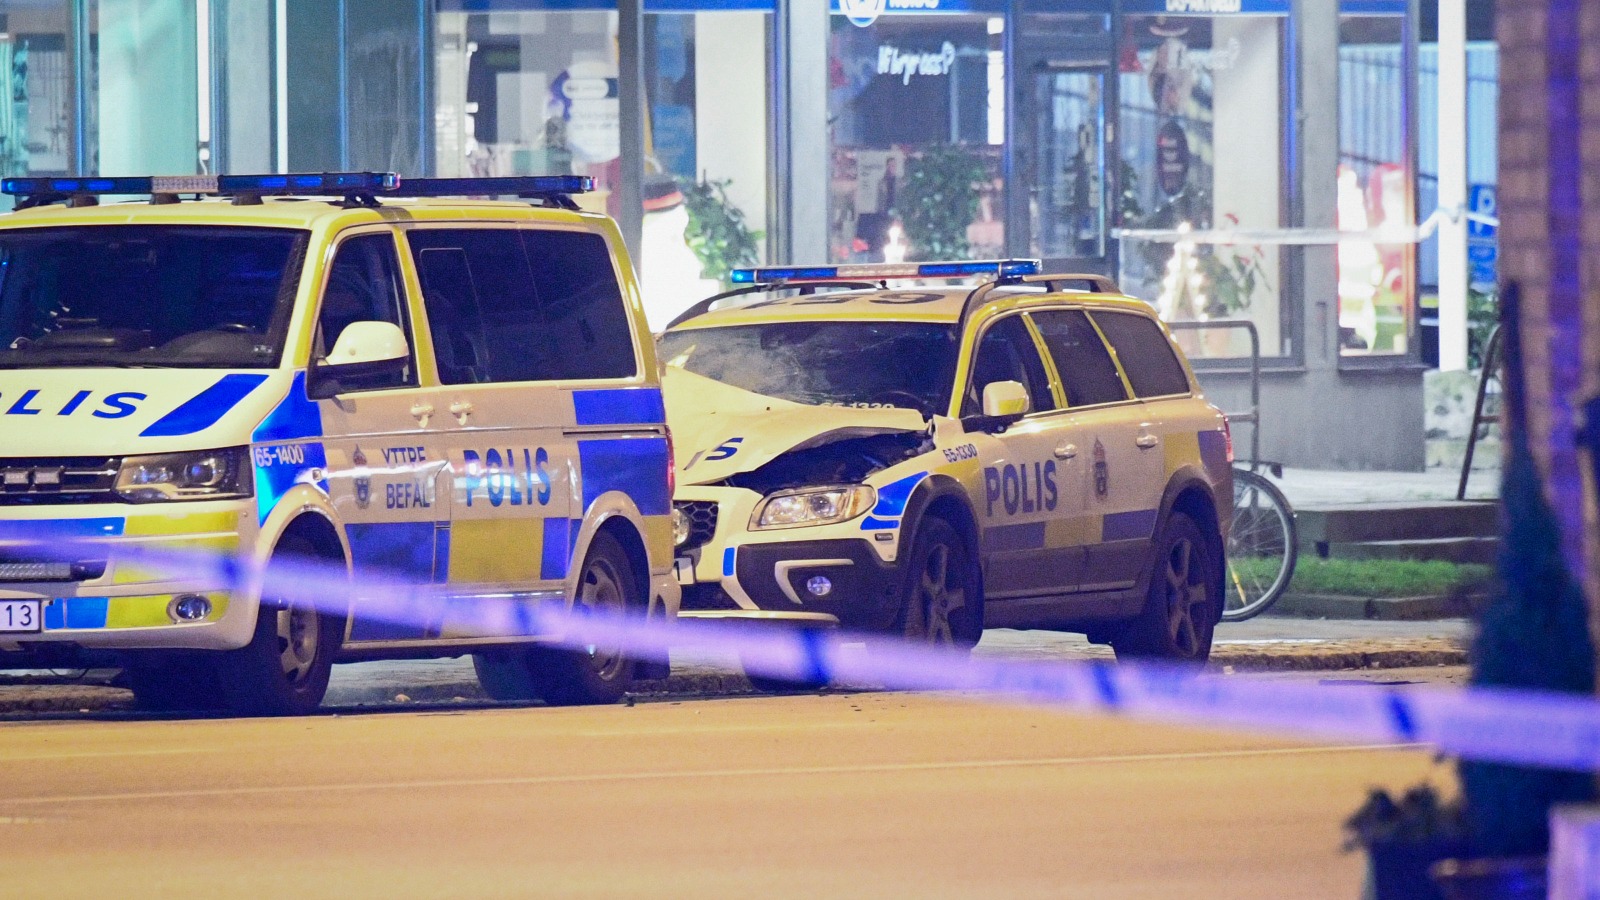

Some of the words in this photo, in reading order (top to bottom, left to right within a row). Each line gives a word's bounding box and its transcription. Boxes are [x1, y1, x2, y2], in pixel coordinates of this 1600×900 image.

[0, 389, 148, 419] LIS
[255, 444, 304, 467] 65-1400
[943, 442, 978, 463] 65-1330
[463, 447, 551, 507] POLIS
[984, 459, 1058, 518] POLIS
[5, 604, 32, 626] 13
